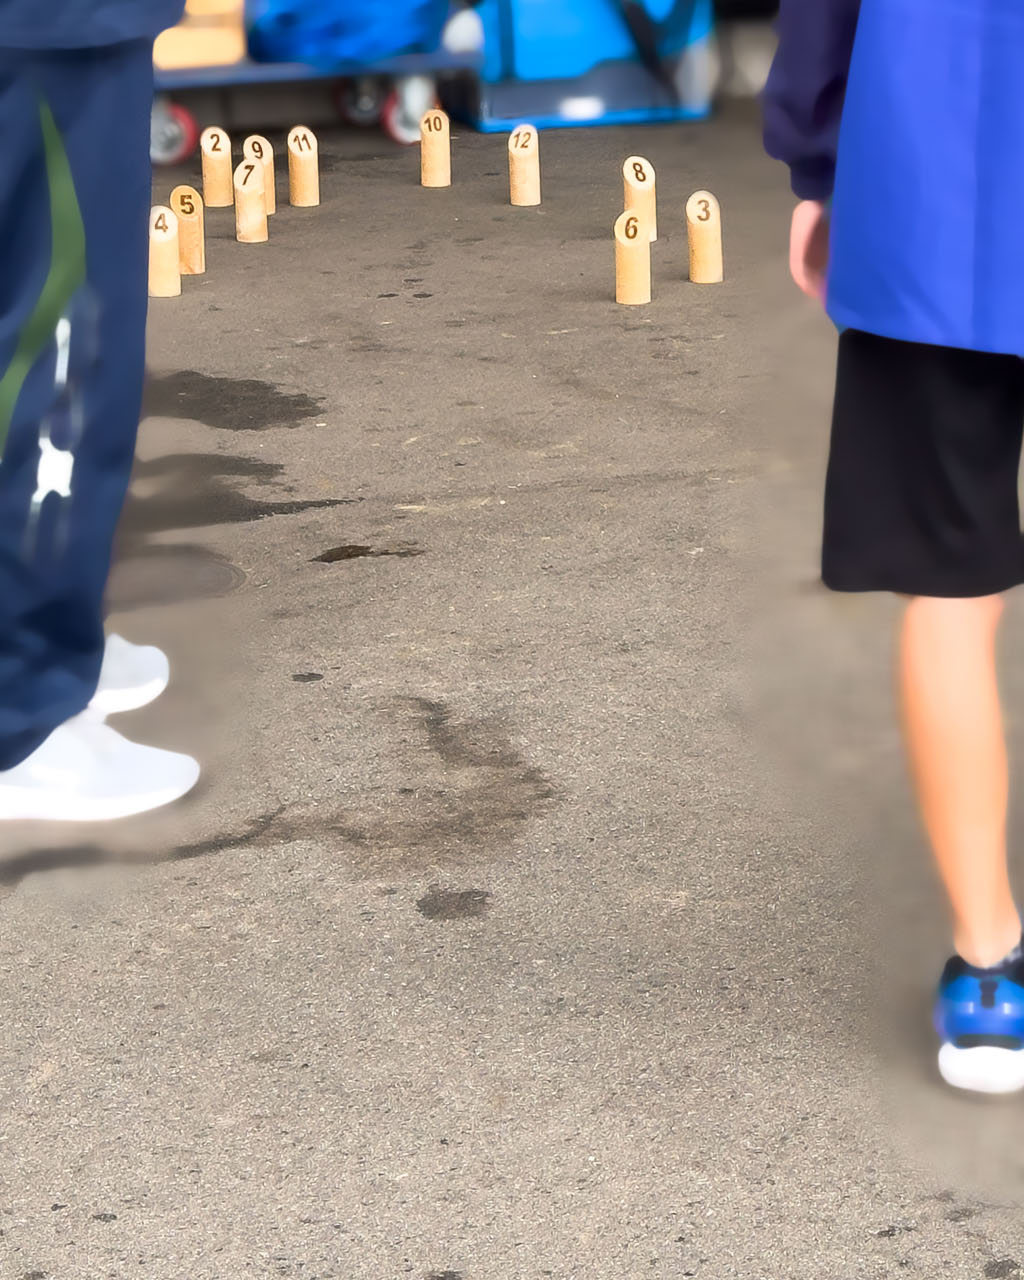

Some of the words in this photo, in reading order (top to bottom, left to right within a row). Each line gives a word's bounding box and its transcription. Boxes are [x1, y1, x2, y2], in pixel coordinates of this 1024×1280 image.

[424, 116, 442, 132] 10
[210, 133, 222, 151] 2
[293, 133, 312, 152] 11
[513, 131, 531, 148] 12
[252, 141, 264, 159] 9
[242, 165, 255, 185] 7
[633, 162, 646, 183] 8
[180, 195, 194, 215] 5
[697, 200, 711, 221] 3
[154, 213, 169, 232] 4
[625, 216, 639, 240] 6
